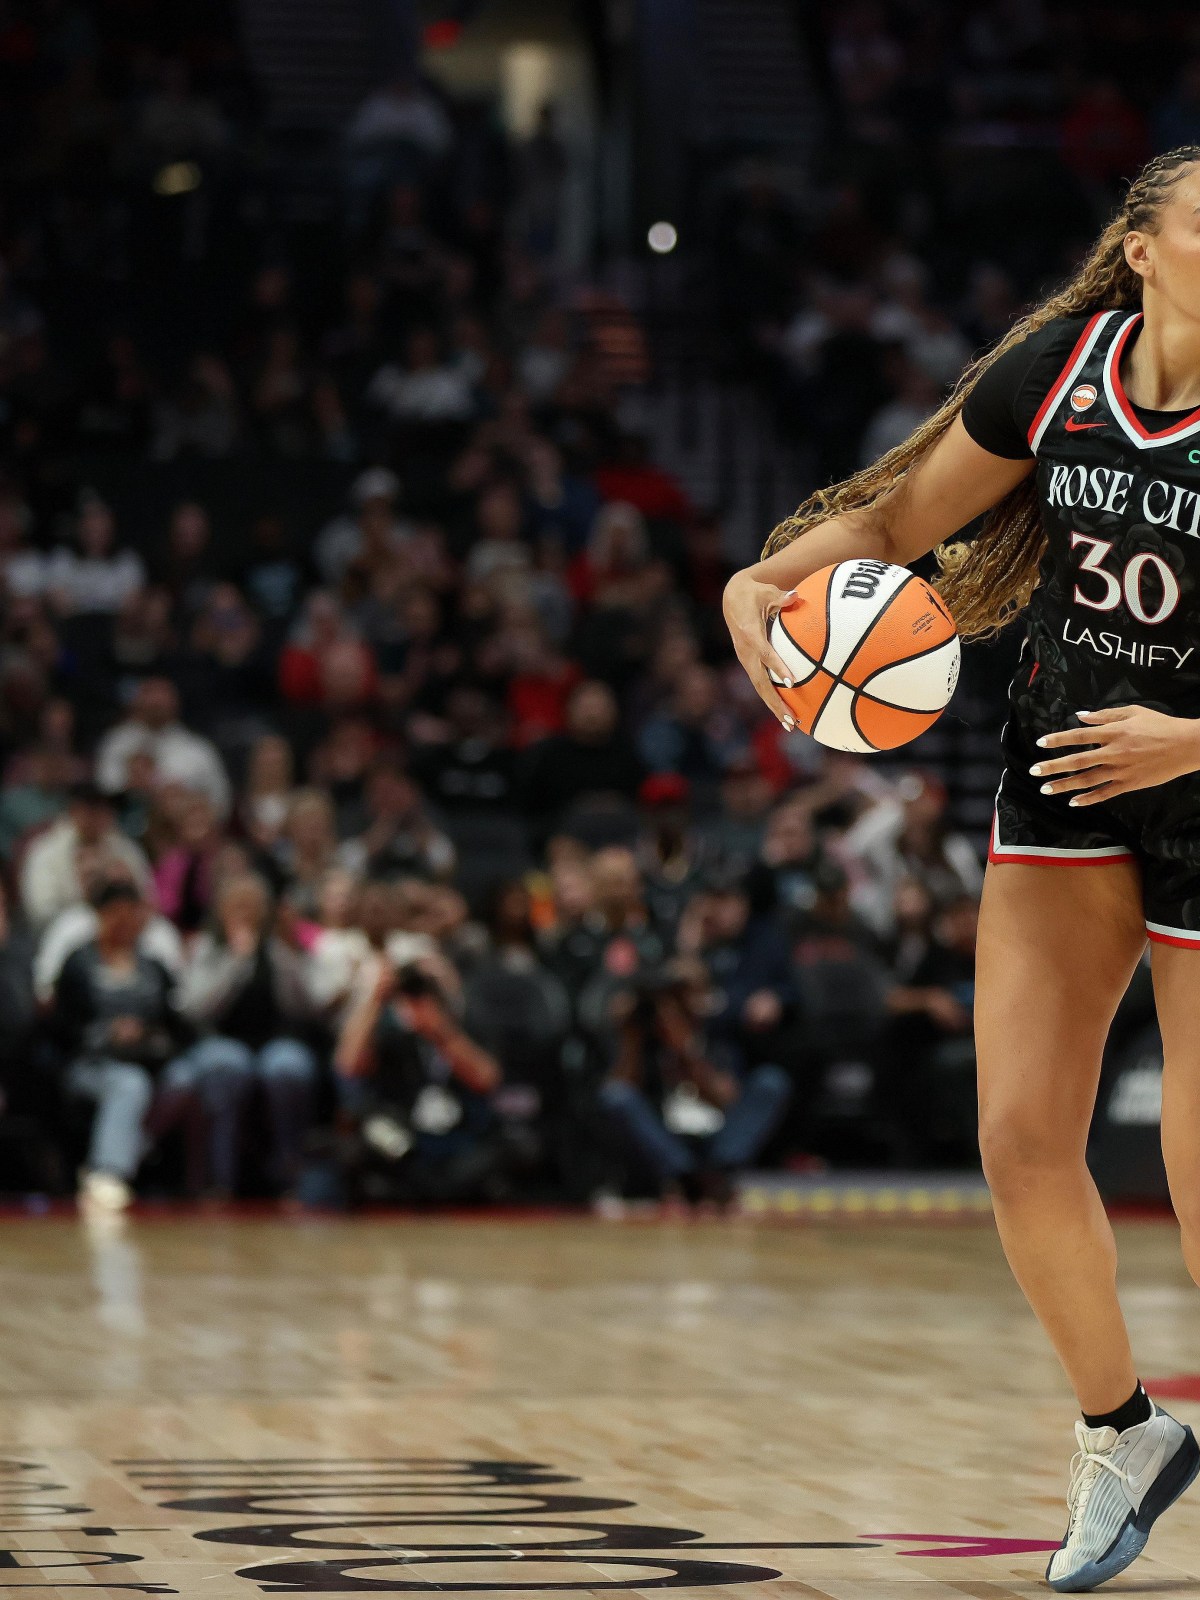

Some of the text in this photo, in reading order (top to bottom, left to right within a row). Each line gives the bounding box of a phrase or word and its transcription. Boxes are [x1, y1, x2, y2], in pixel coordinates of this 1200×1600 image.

[1047, 465, 1135, 515] ROSE
[1070, 531, 1181, 625] 30
[1062, 618, 1195, 670] LASHIFY
[112, 1459, 884, 1593] moda
